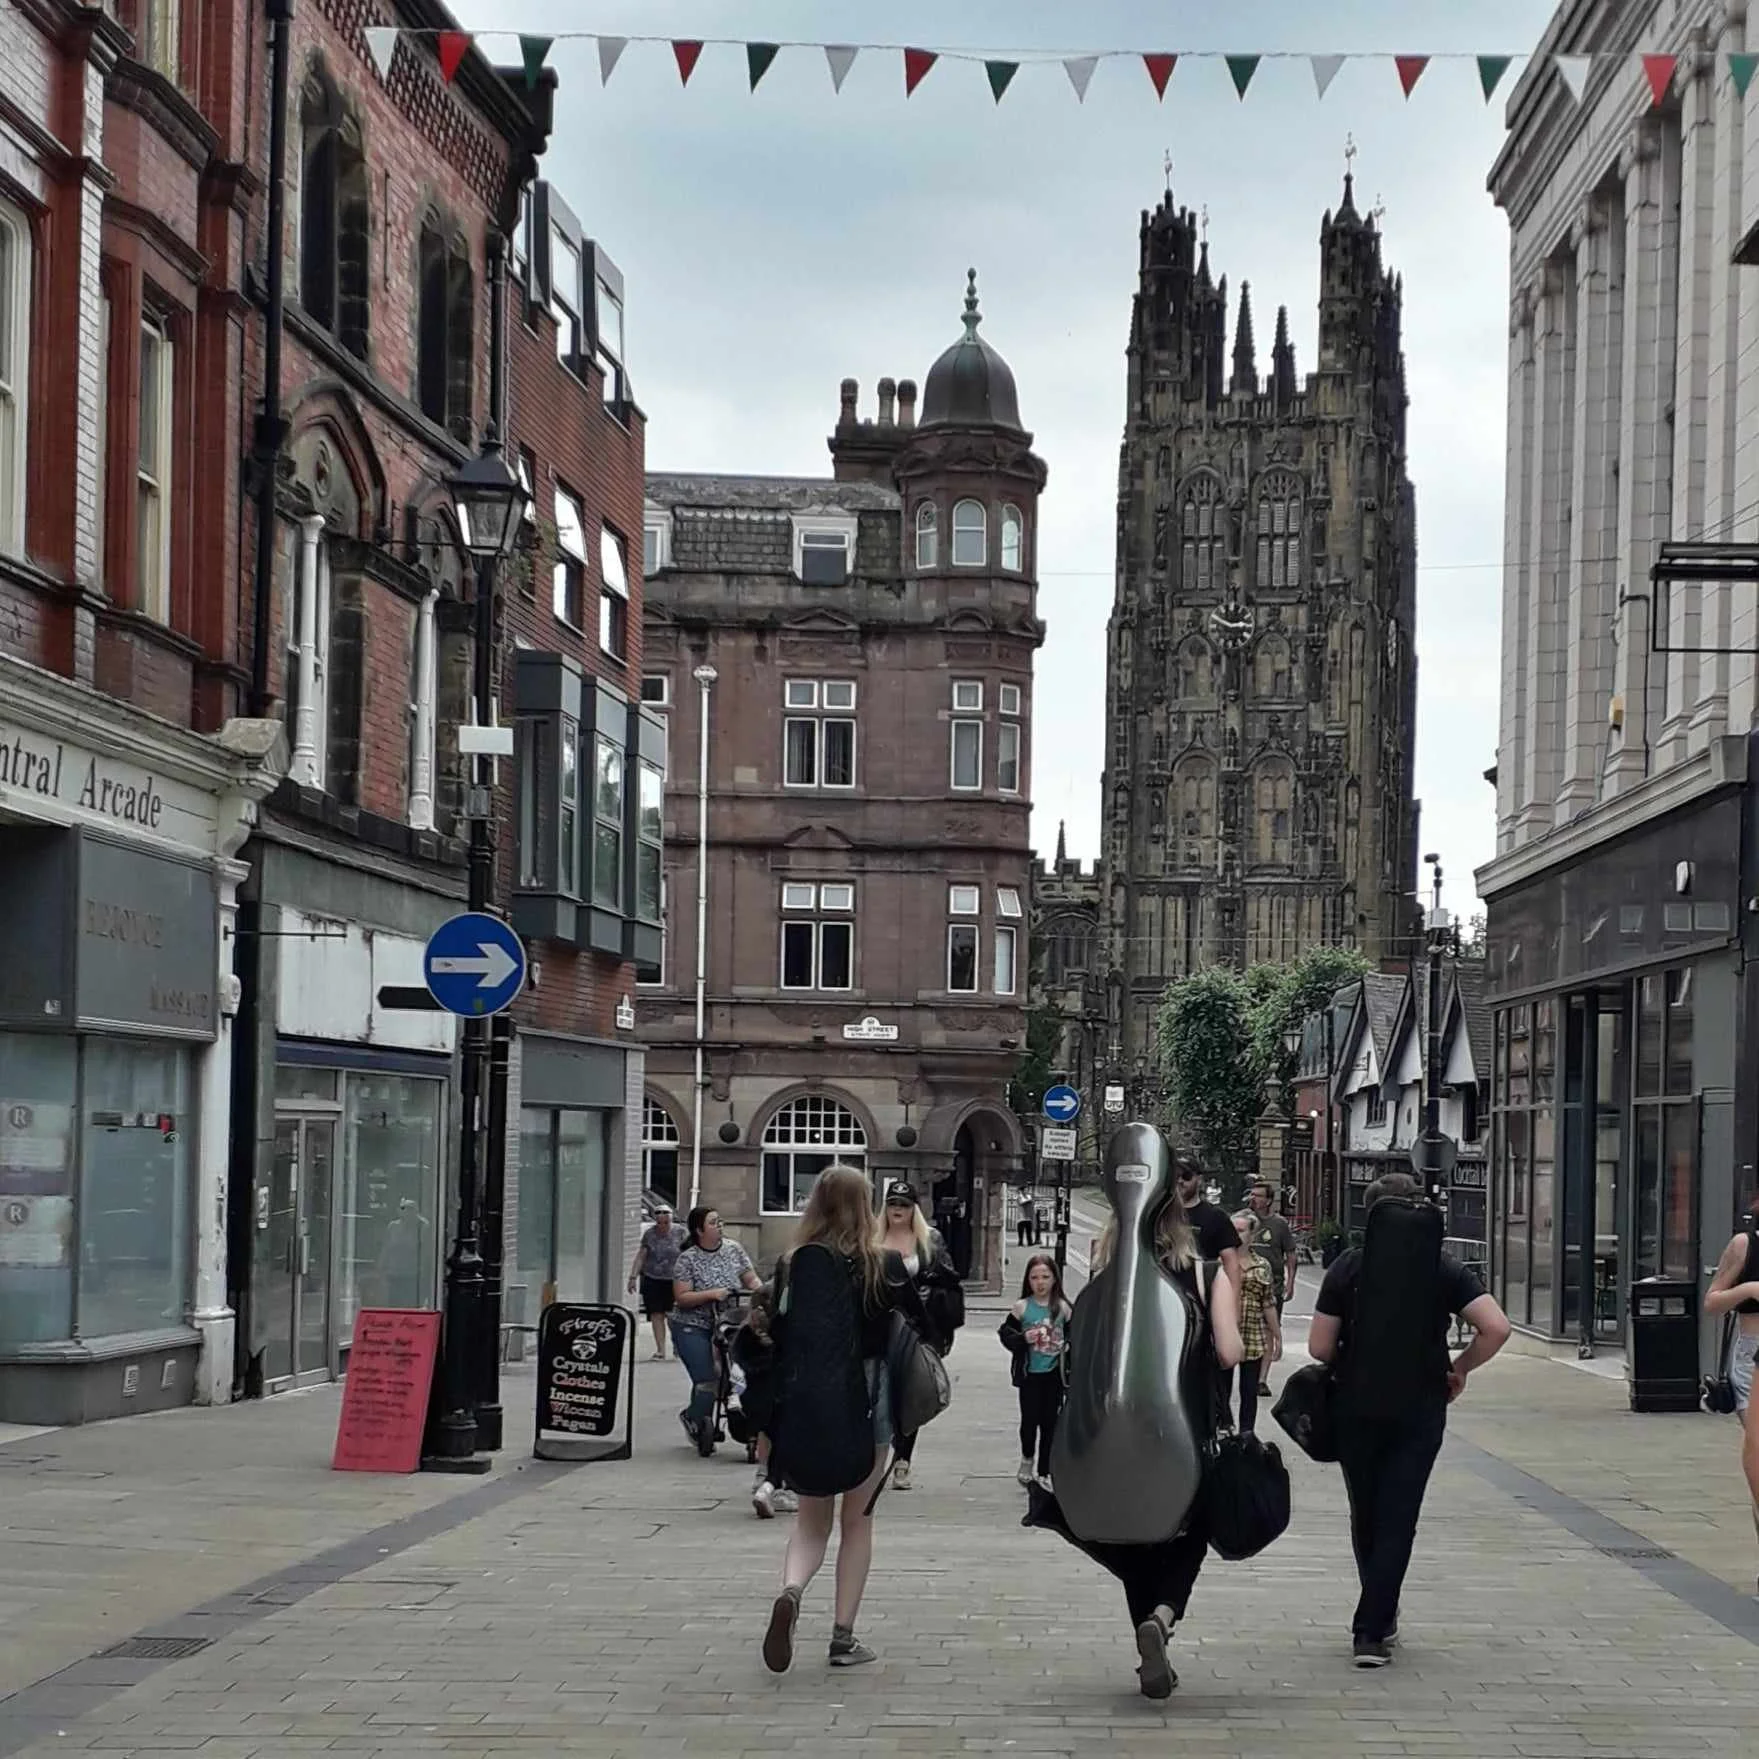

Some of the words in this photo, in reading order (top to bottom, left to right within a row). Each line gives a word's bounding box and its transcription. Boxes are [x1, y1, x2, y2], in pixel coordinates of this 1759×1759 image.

[78, 756, 162, 829] Arcade
[14, 1107, 27, 1126] R
[9, 1202, 22, 1222] R
[552, 1356, 610, 1374] Crystals
[552, 1371, 606, 1390] Clothes
[549, 1387, 605, 1406] Incense
[551, 1414, 596, 1432] Pagan
